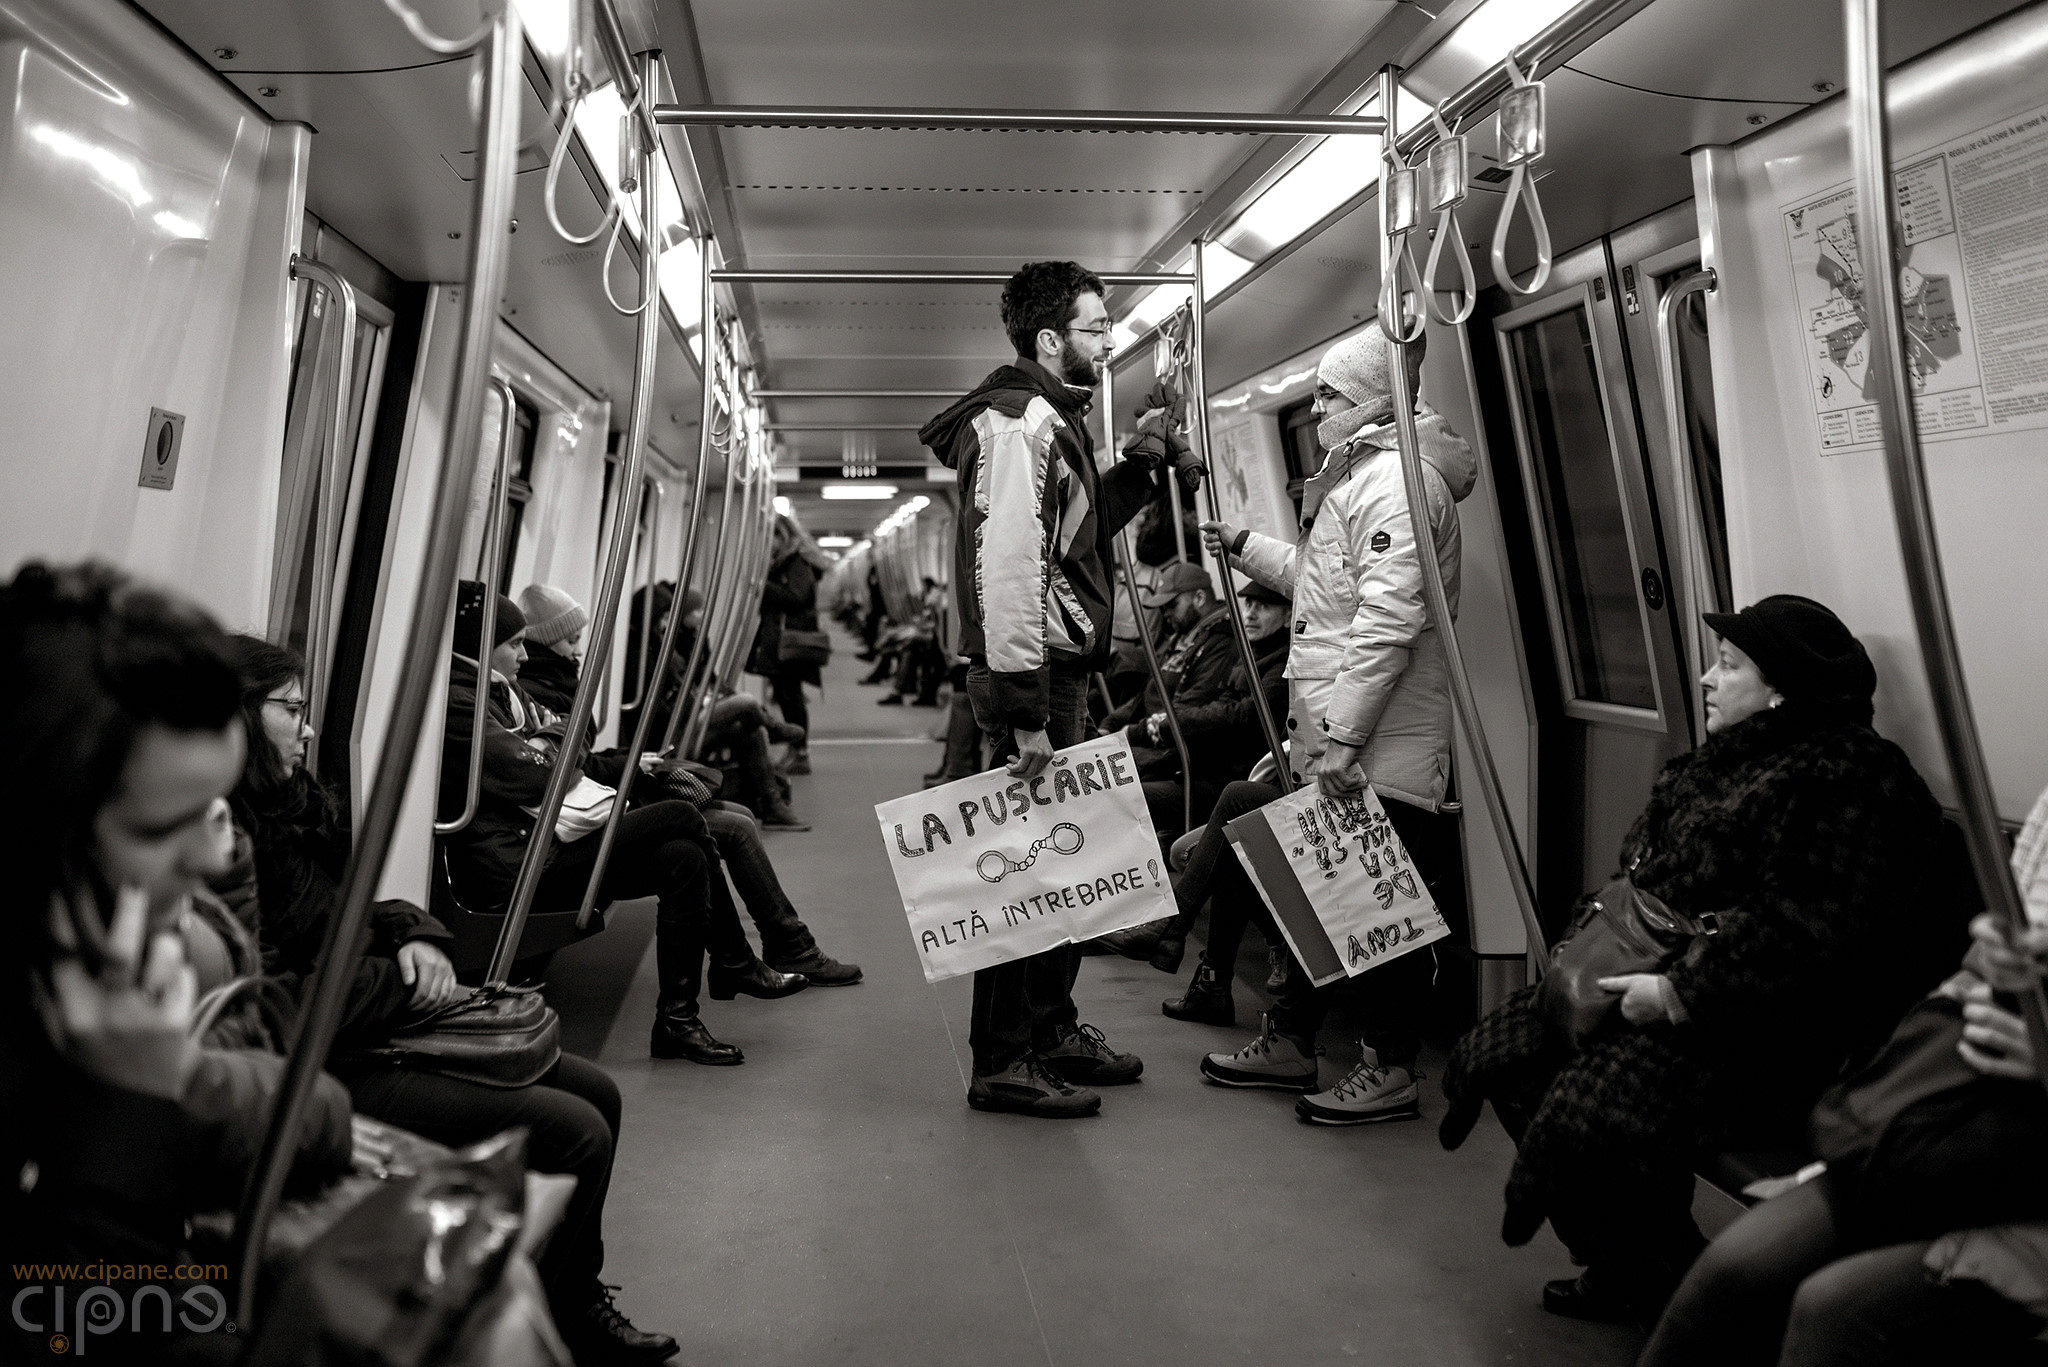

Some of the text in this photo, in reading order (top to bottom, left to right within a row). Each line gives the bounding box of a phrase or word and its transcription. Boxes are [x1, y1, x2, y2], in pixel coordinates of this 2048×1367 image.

[894, 813, 952, 858] LA
[921, 909, 989, 954] ALTĂ
[1347, 916, 1425, 968] TONY
